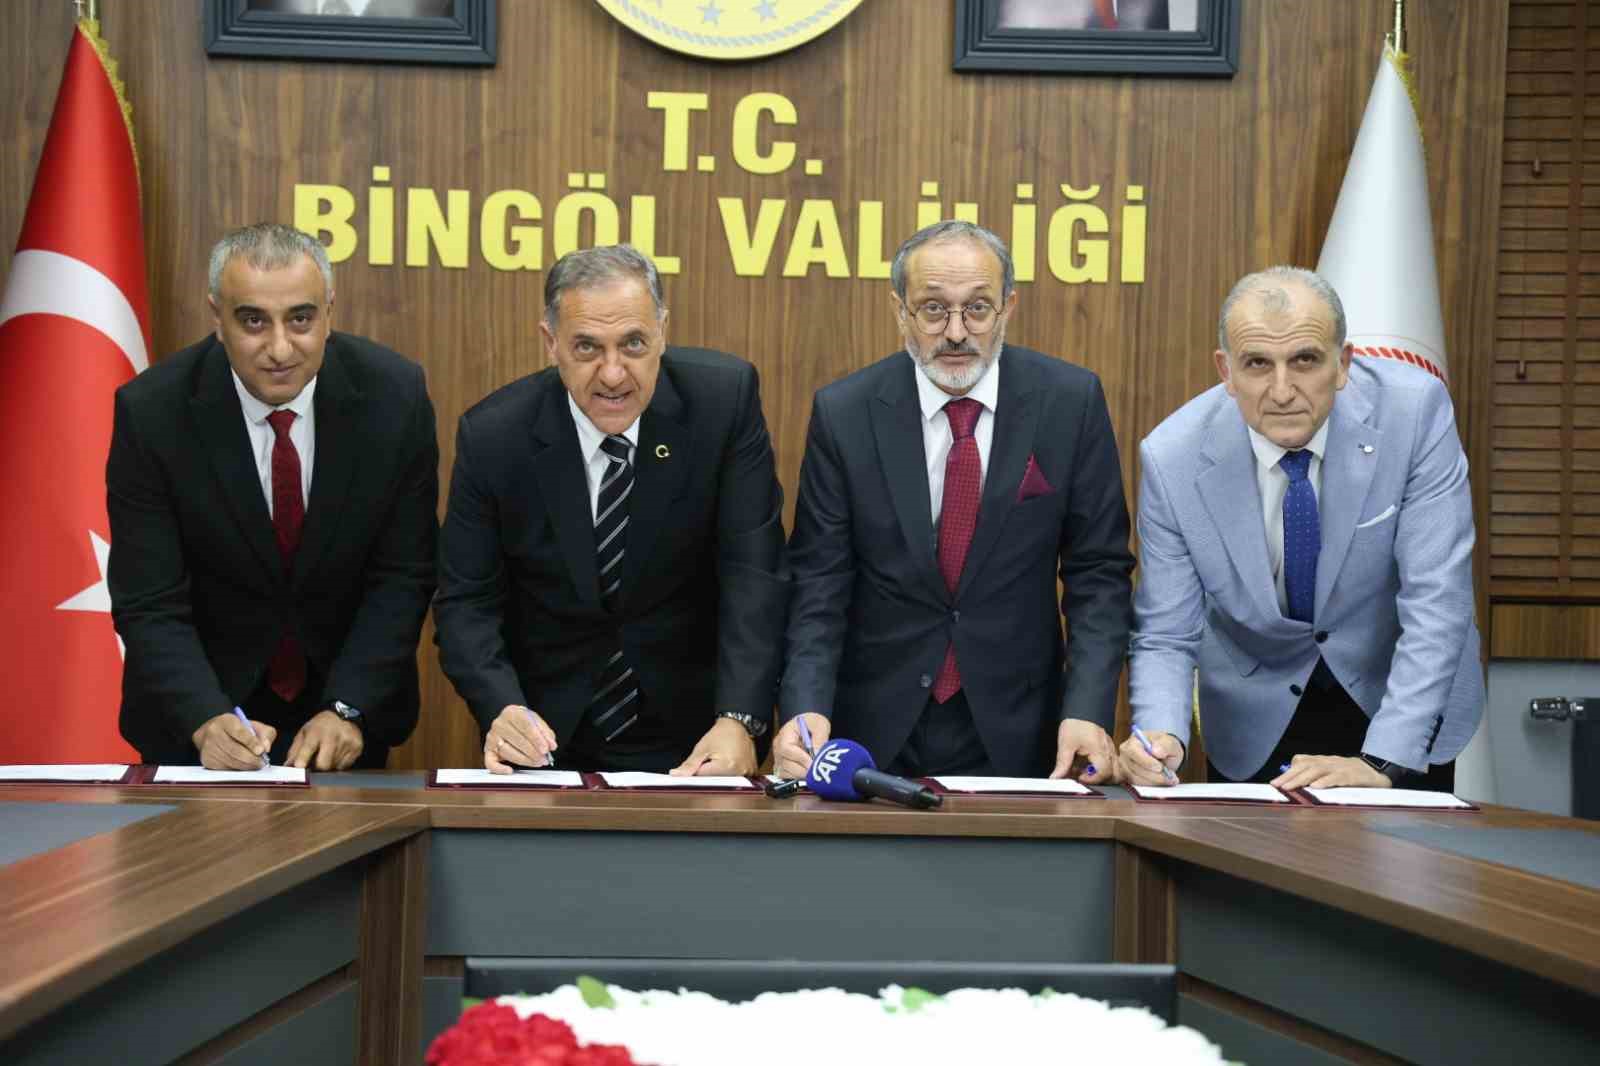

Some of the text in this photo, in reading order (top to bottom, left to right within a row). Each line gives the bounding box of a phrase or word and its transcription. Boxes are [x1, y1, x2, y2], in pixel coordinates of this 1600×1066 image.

[647, 91, 823, 175] T.C.
[293, 166, 1147, 284] BİNGÖL VALİĞİ
[814, 745, 850, 784] AA
